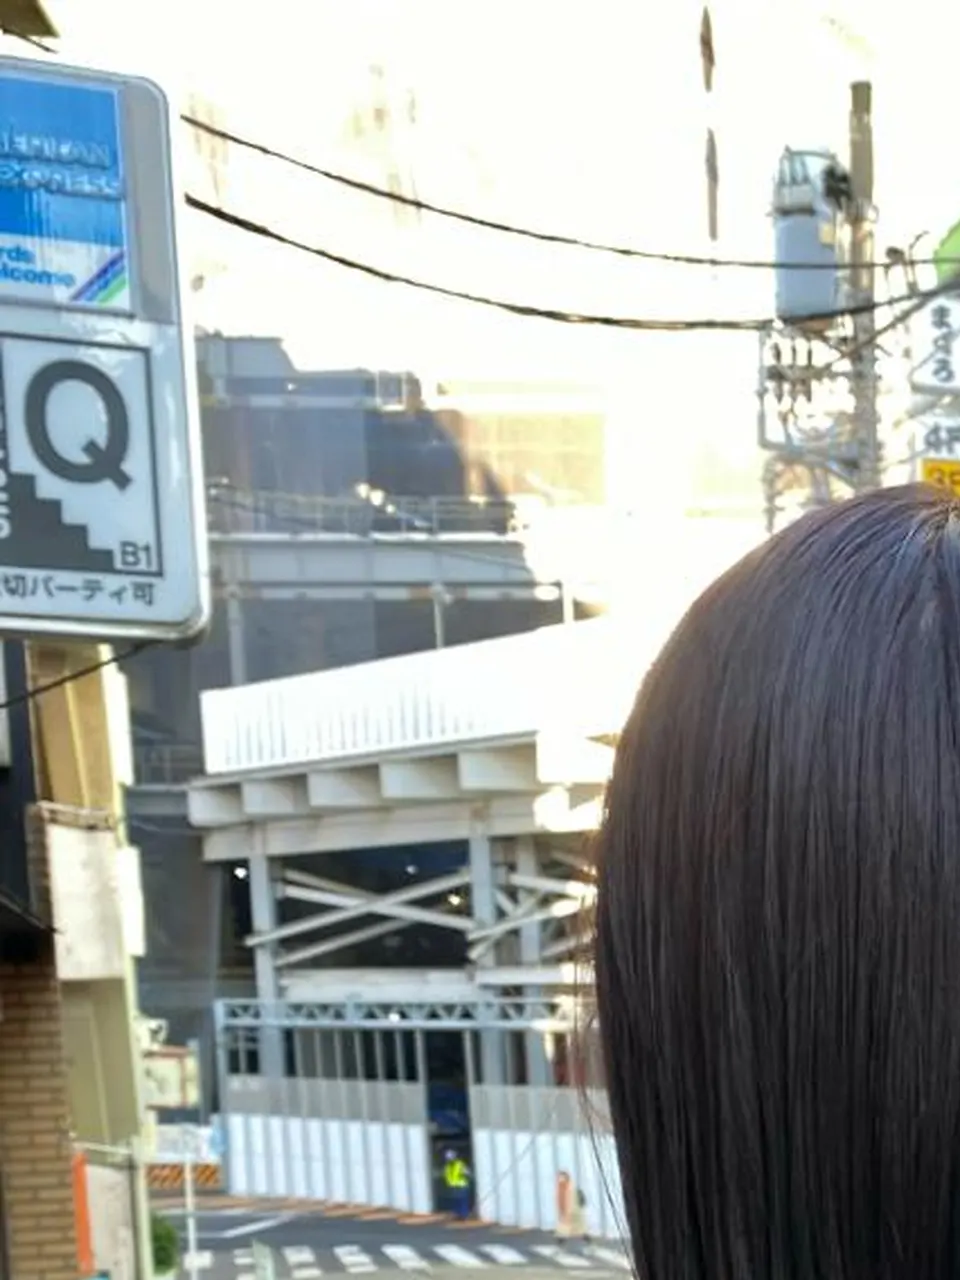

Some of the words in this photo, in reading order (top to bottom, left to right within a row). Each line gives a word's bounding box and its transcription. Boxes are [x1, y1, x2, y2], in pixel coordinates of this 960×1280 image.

[0, 263, 77, 288] lcome
[24, 360, 133, 494] Q
[120, 540, 152, 569] B1
[0, 574, 155, 607] 切パーティ可
